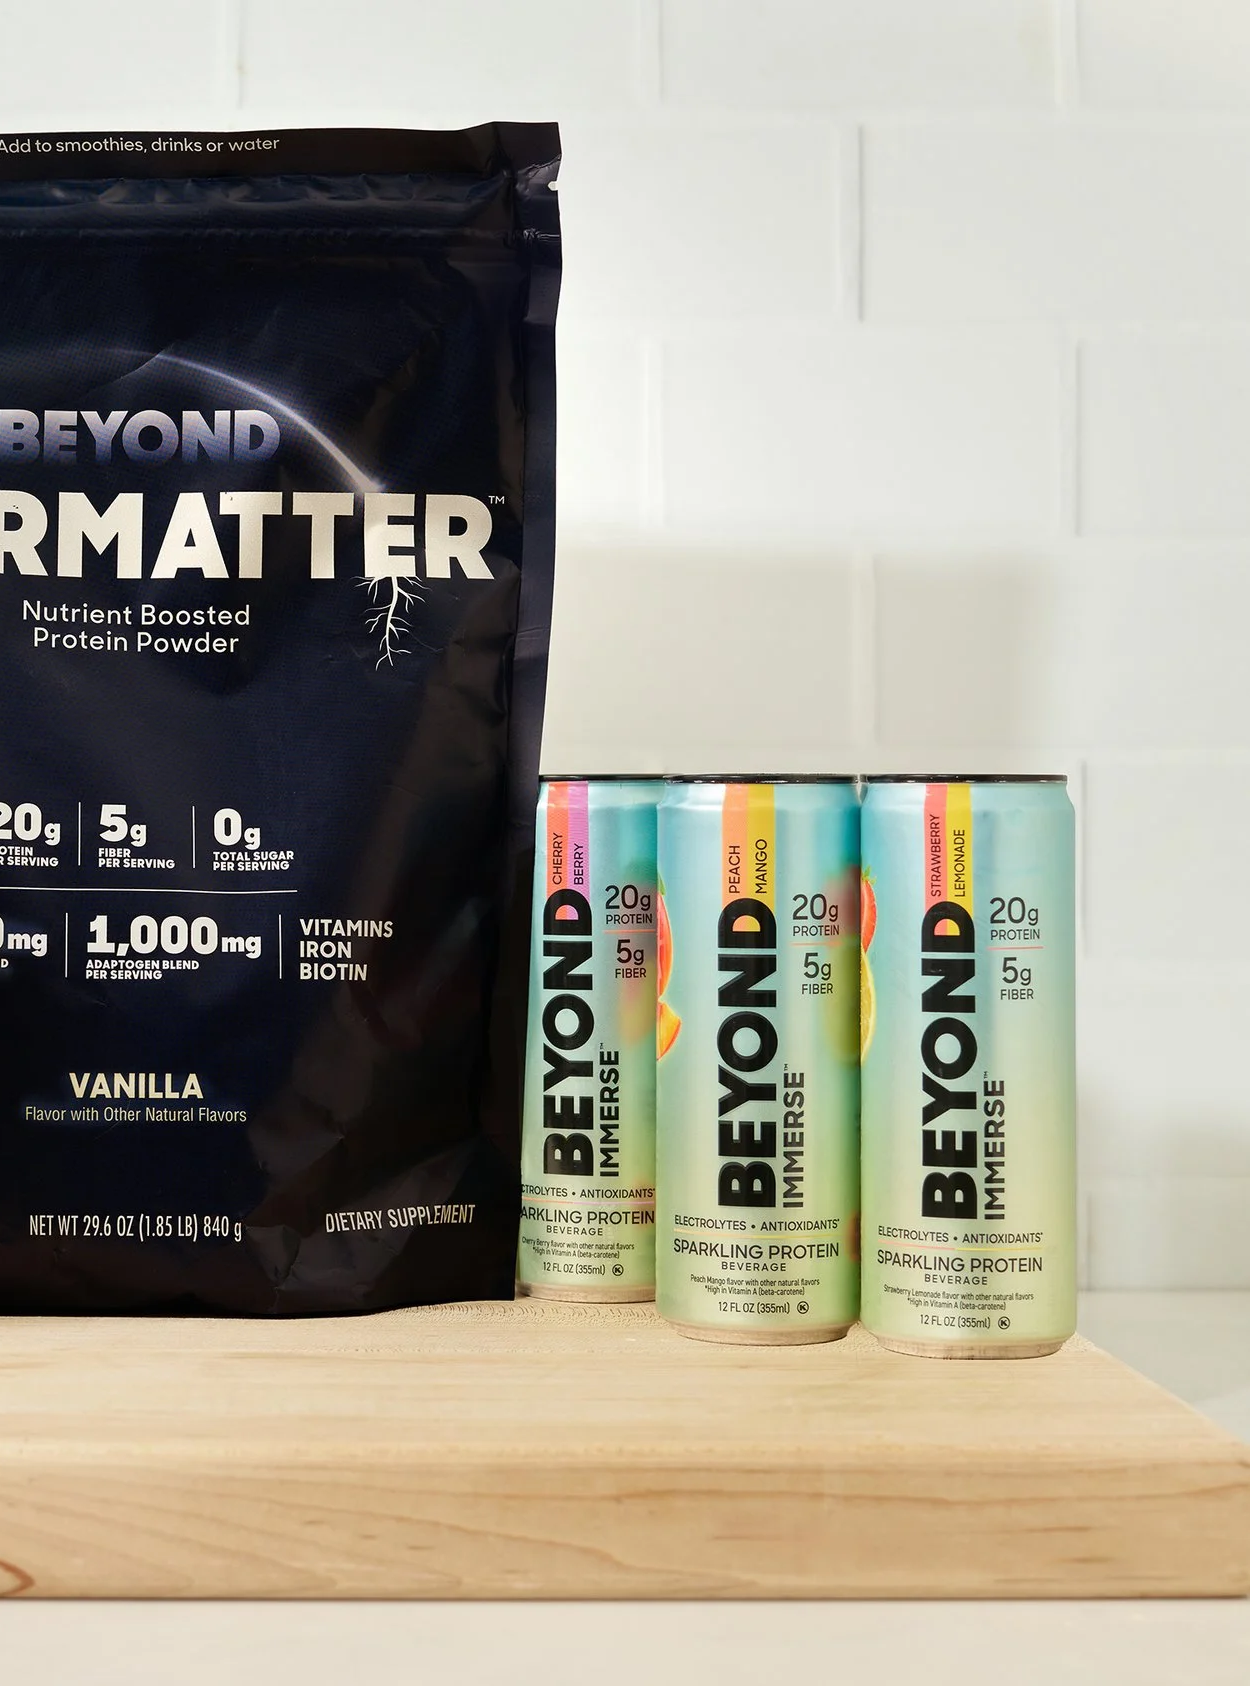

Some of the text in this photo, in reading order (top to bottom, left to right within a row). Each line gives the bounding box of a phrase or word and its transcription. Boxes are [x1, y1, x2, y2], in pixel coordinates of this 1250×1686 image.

[36, 140, 52, 153] to
[56, 136, 146, 155] smoothies,
[151, 136, 201, 152] drinks
[206, 140, 224, 152] or
[229, 138, 279, 151] water
[23, 602, 250, 627] Nutrient Boosted
[33, 628, 239, 654] Protein Powder
[99, 804, 146, 846] 5g
[214, 808, 261, 850] 0g
[8, 856, 58, 867] SERVING
[99, 848, 130, 858] FIBER
[99, 858, 174, 869] PER SERVING
[213, 850, 294, 861] TOTAL SUGAR
[552, 832, 563, 885] CHERRY
[574, 843, 583, 885] BERRY
[930, 814, 941, 897] STRAWBERRY
[954, 829, 965, 897] LEMONADE
[213, 860, 289, 871] PER SERVING
[729, 845, 740, 894] PEACH
[755, 839, 768, 894] MANGO
[604, 886, 651, 914] 20g
[792, 894, 839, 922] 20g
[989, 897, 1039, 924] 20g
[299, 919, 393, 938] VITAMINS
[606, 914, 652, 925] PROTEIN
[86, 915, 261, 958] 1,000mg
[793, 925, 839, 937] PROTEIN
[990, 929, 1040, 940] PROTEIN
[300, 941, 352, 958] IRON
[616, 939, 645, 966] 5g
[86, 959, 199, 970] ADAPTOGEN BLEND
[86, 969, 162, 980] PER SERVING
[300, 963, 367, 981] BIOTIN
[615, 968, 646, 979] FIBER
[804, 954, 831, 979] 5g
[1002, 957, 1032, 986] 5g
[801, 983, 834, 995] FIBER
[1000, 988, 1034, 1000] FIBER
[543, 889, 594, 1176] BEYOND
[717, 897, 778, 1208] BEYOND
[921, 901, 978, 1219] BEYOND
[69, 1072, 203, 1098] VANILLA
[25, 1106, 246, 1122] Flavor with Other Natural Flavors
[30, 1215, 242, 1242] NET WT 29.6 OZ (1.85 LB) 840 g
[325, 1204, 475, 1233] DIETARY SUPPLEMENT
[675, 1215, 746, 1230] ELECTROLYTES
[674, 1239, 839, 1259] SPARKLING PROTEIN
[722, 1262, 786, 1271] BEVERAGE
[691, 1274, 706, 1283] Peach
[707, 1277, 725, 1286] Mango
[745, 1278, 758, 1286] with
[719, 1302, 790, 1314] 12 FL OZ (355ml)
